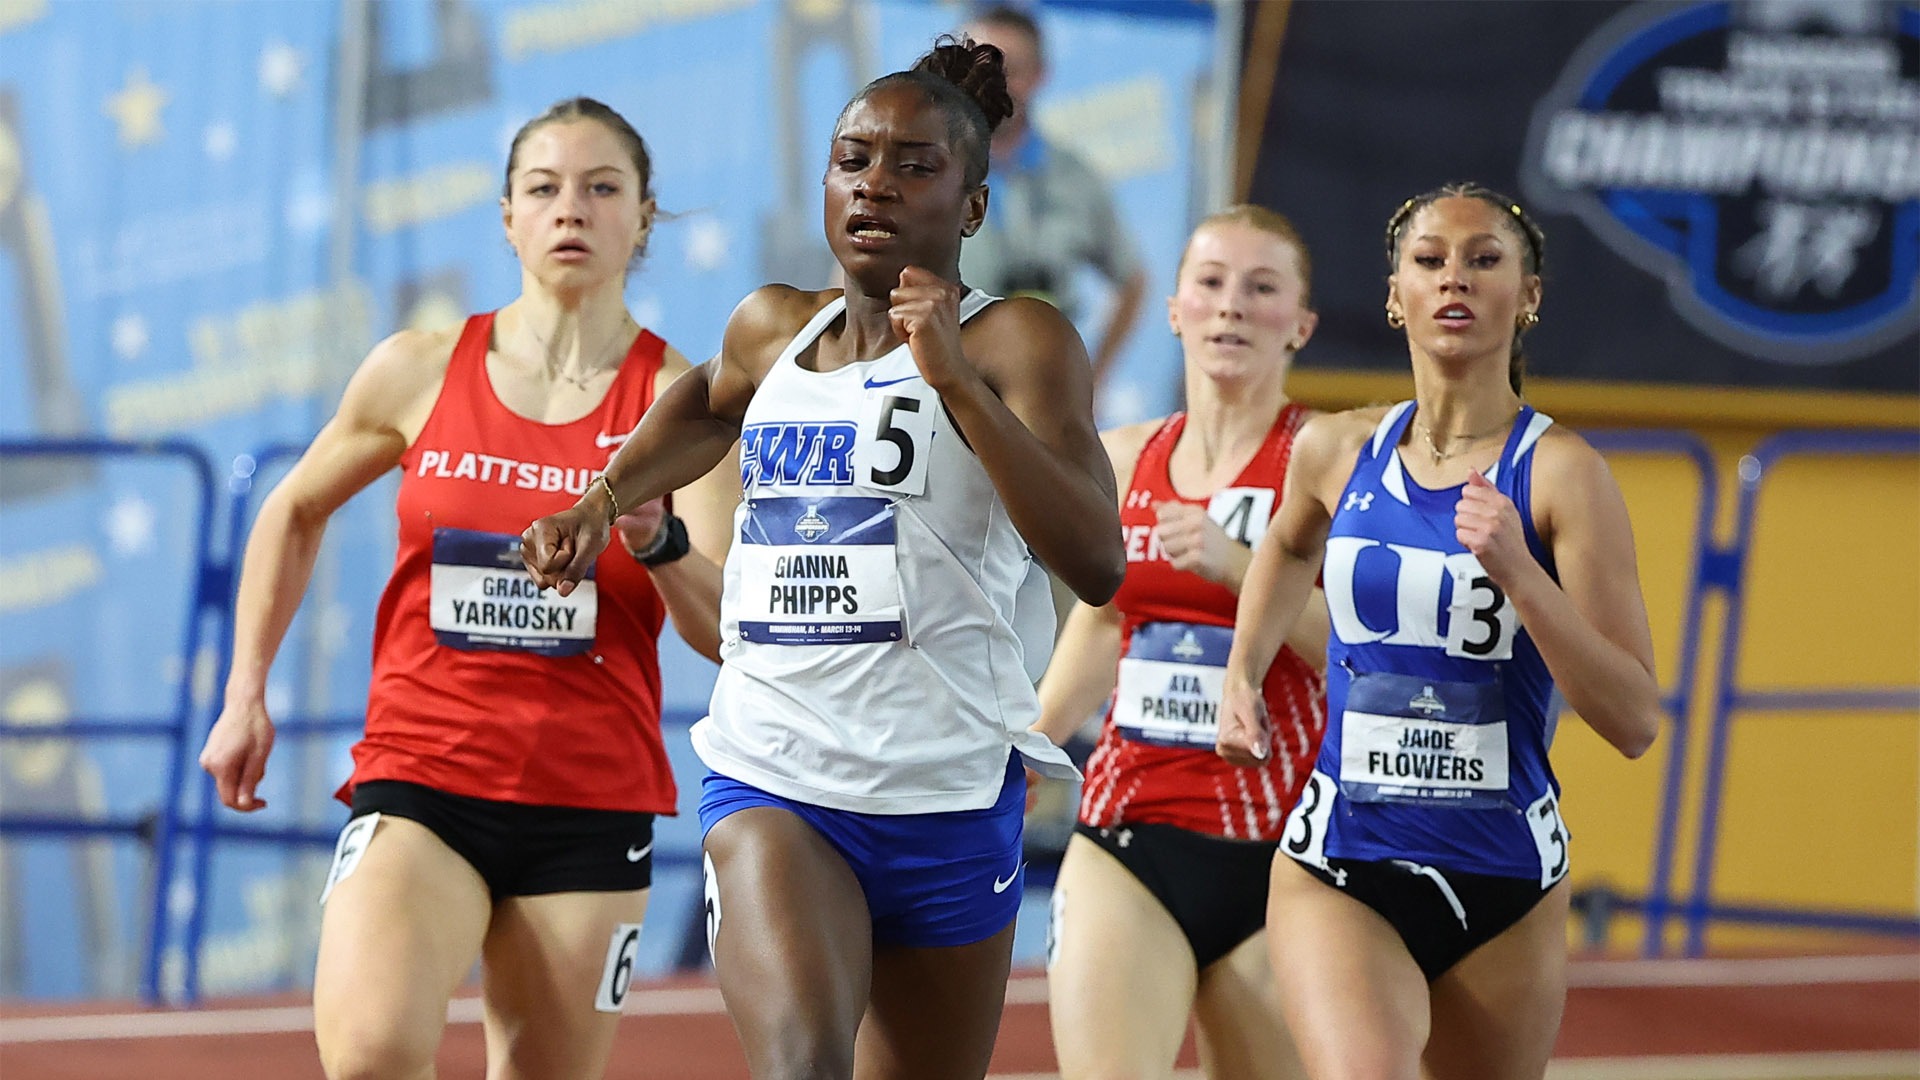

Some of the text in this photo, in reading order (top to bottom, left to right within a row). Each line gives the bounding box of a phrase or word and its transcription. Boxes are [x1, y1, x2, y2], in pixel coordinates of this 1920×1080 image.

[870, 395, 921, 486] 5
[417, 450, 606, 496] PLATTSBU
[774, 555, 850, 579] GIANNA
[452, 600, 577, 631] YARKOSKY
[769, 585, 859, 615] PHIPPS
[1461, 575, 1506, 656] 3
[1397, 727, 1457, 751] JAIDE
[1368, 751, 1484, 782] FLOWERS
[1288, 776, 1321, 855] 3
[1539, 797, 1566, 879] 3
[612, 928, 639, 1006] 6
